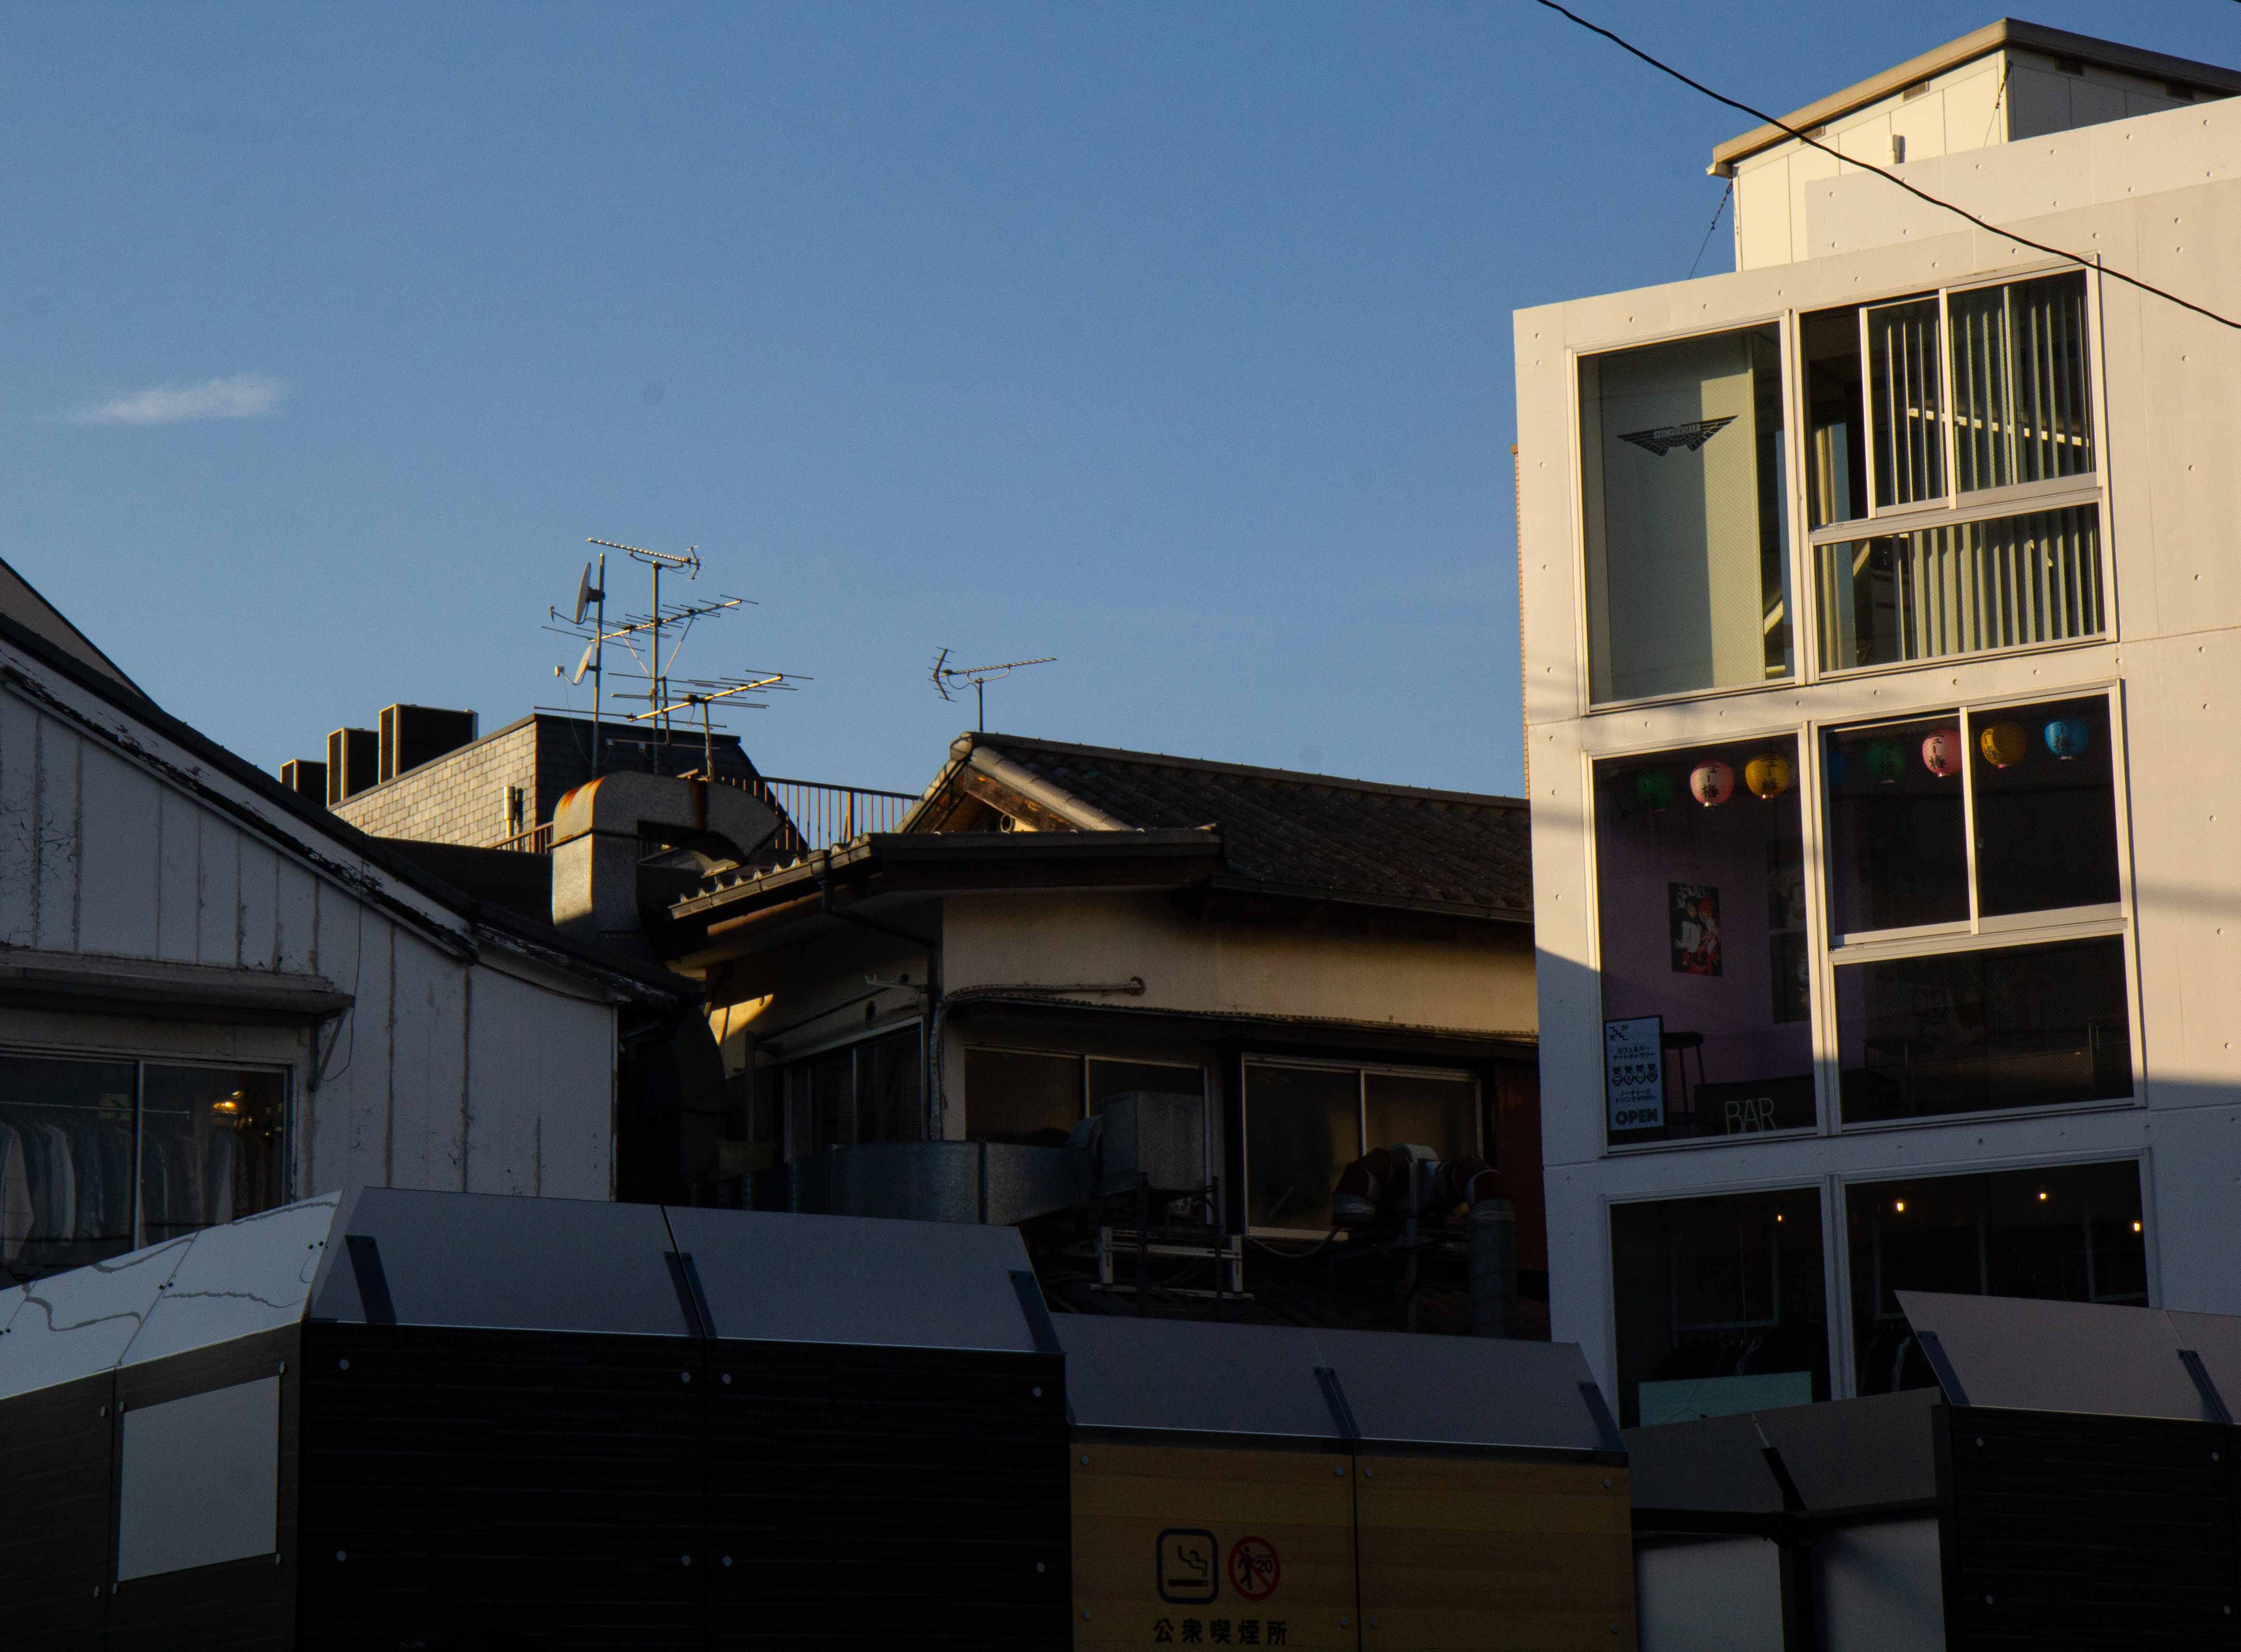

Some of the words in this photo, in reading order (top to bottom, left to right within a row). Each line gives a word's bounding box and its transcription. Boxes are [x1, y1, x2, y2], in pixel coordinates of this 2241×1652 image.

[1615, 1107, 1658, 1125] OPEN
[1724, 1097, 1778, 1134] BAR
[1256, 1559, 1273, 1573] 20
[1153, 1617, 1287, 1645] 公衆喫煙所
